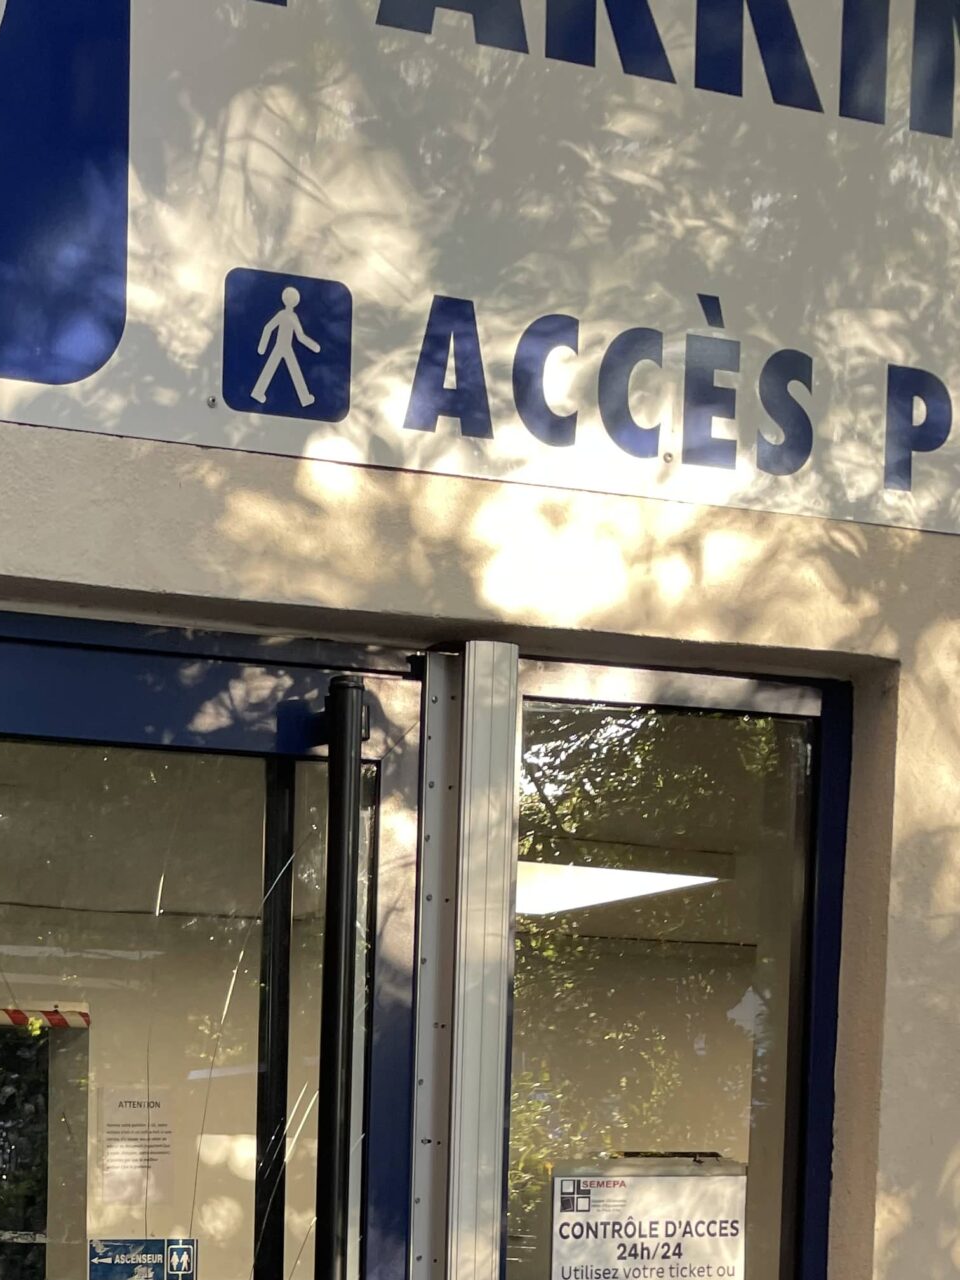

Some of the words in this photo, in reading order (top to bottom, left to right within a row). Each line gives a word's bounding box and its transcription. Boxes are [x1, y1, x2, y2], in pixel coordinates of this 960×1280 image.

[403, 292, 813, 477] ACCÈS
[883, 363, 954, 491] P
[118, 1100, 161, 1109] ATTENTION
[581, 1180, 627, 1189] SEMEPA
[558, 1216, 659, 1240] CONTRÔLE
[664, 1219, 740, 1239] D'ACCES
[113, 1253, 163, 1264] ASCENSEUR
[616, 1241, 683, 1261] 24h/24
[560, 1265, 620, 1280] Utilisez
[623, 1266, 665, 1279] votre
[669, 1263, 713, 1279] ticket
[716, 1266, 735, 1278] ou
